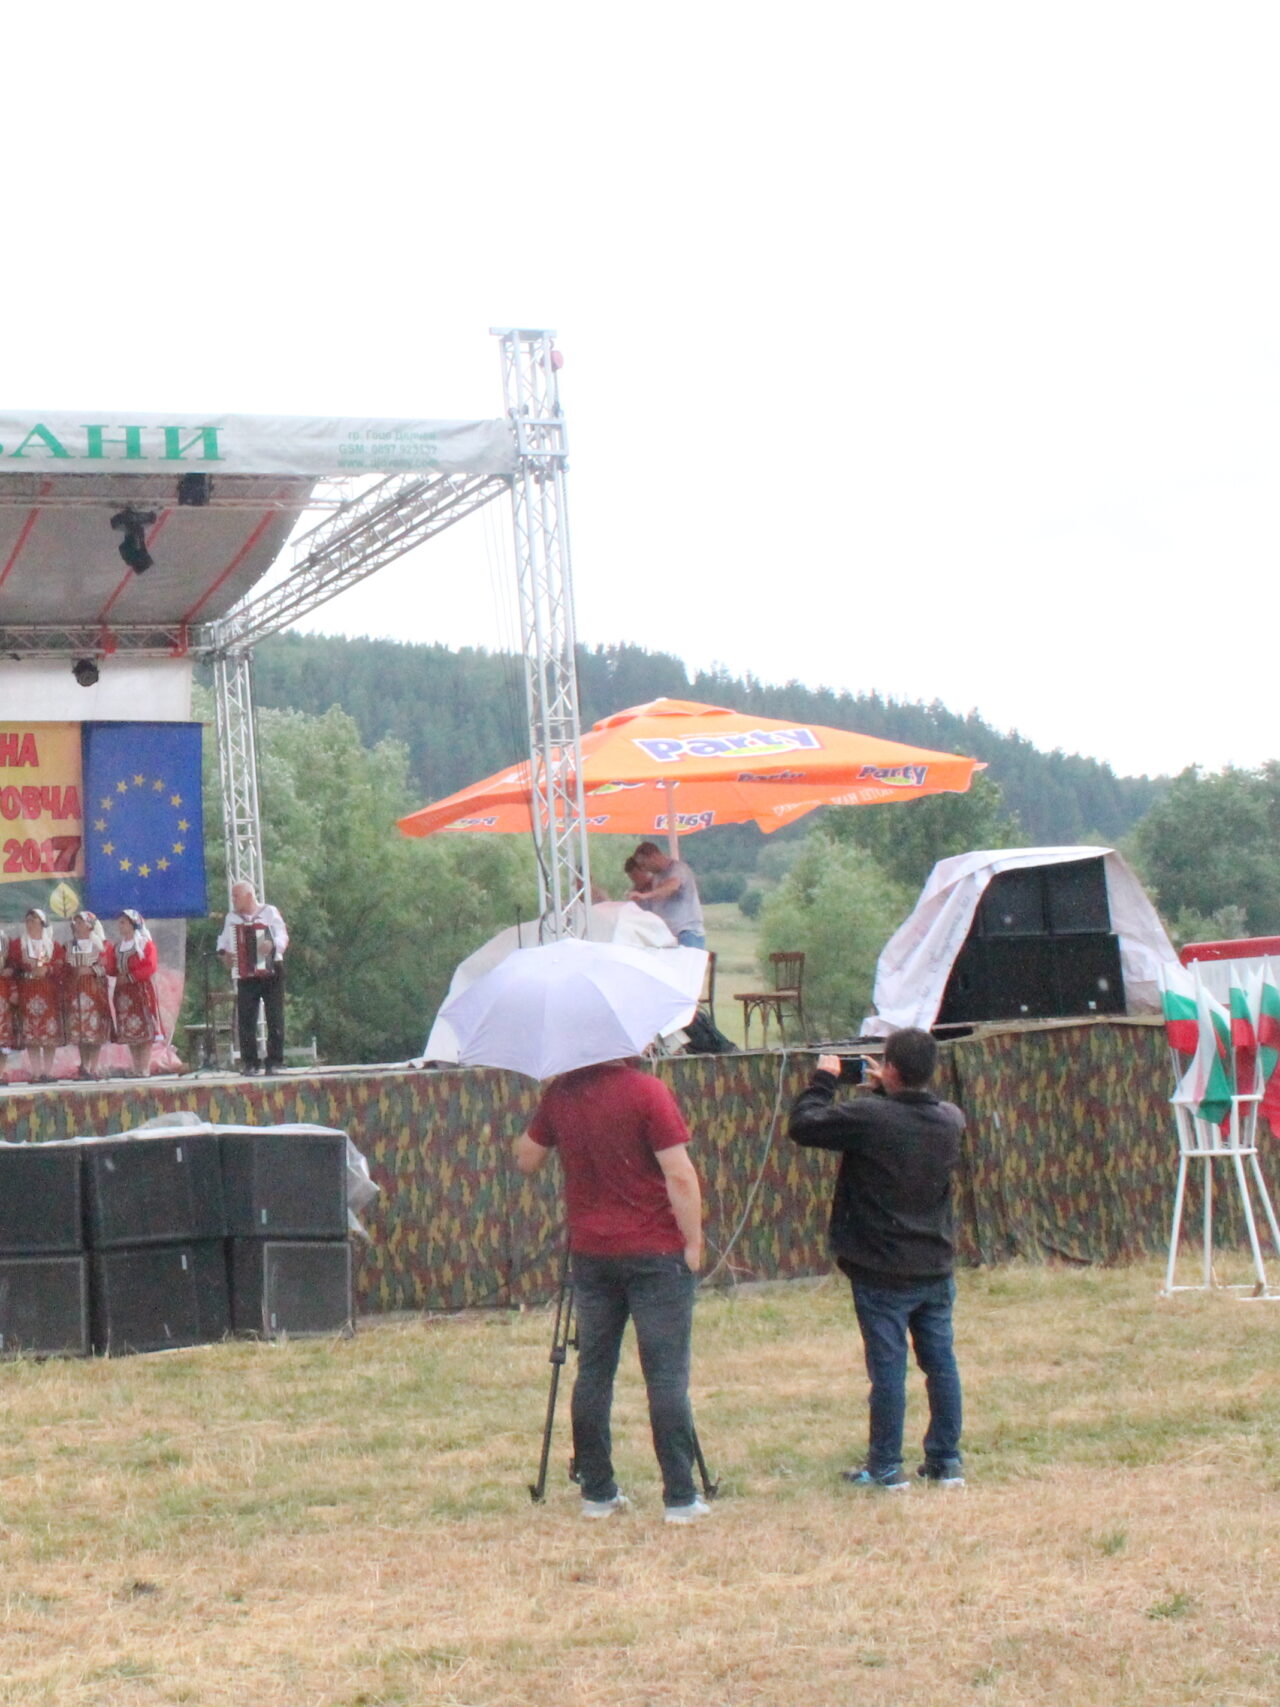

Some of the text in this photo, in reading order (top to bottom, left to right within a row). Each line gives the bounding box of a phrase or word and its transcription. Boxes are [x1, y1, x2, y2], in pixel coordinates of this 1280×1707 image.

[634, 728, 820, 761] Party
[858, 764, 928, 786] Party
[3, 835, 82, 874] 2017
